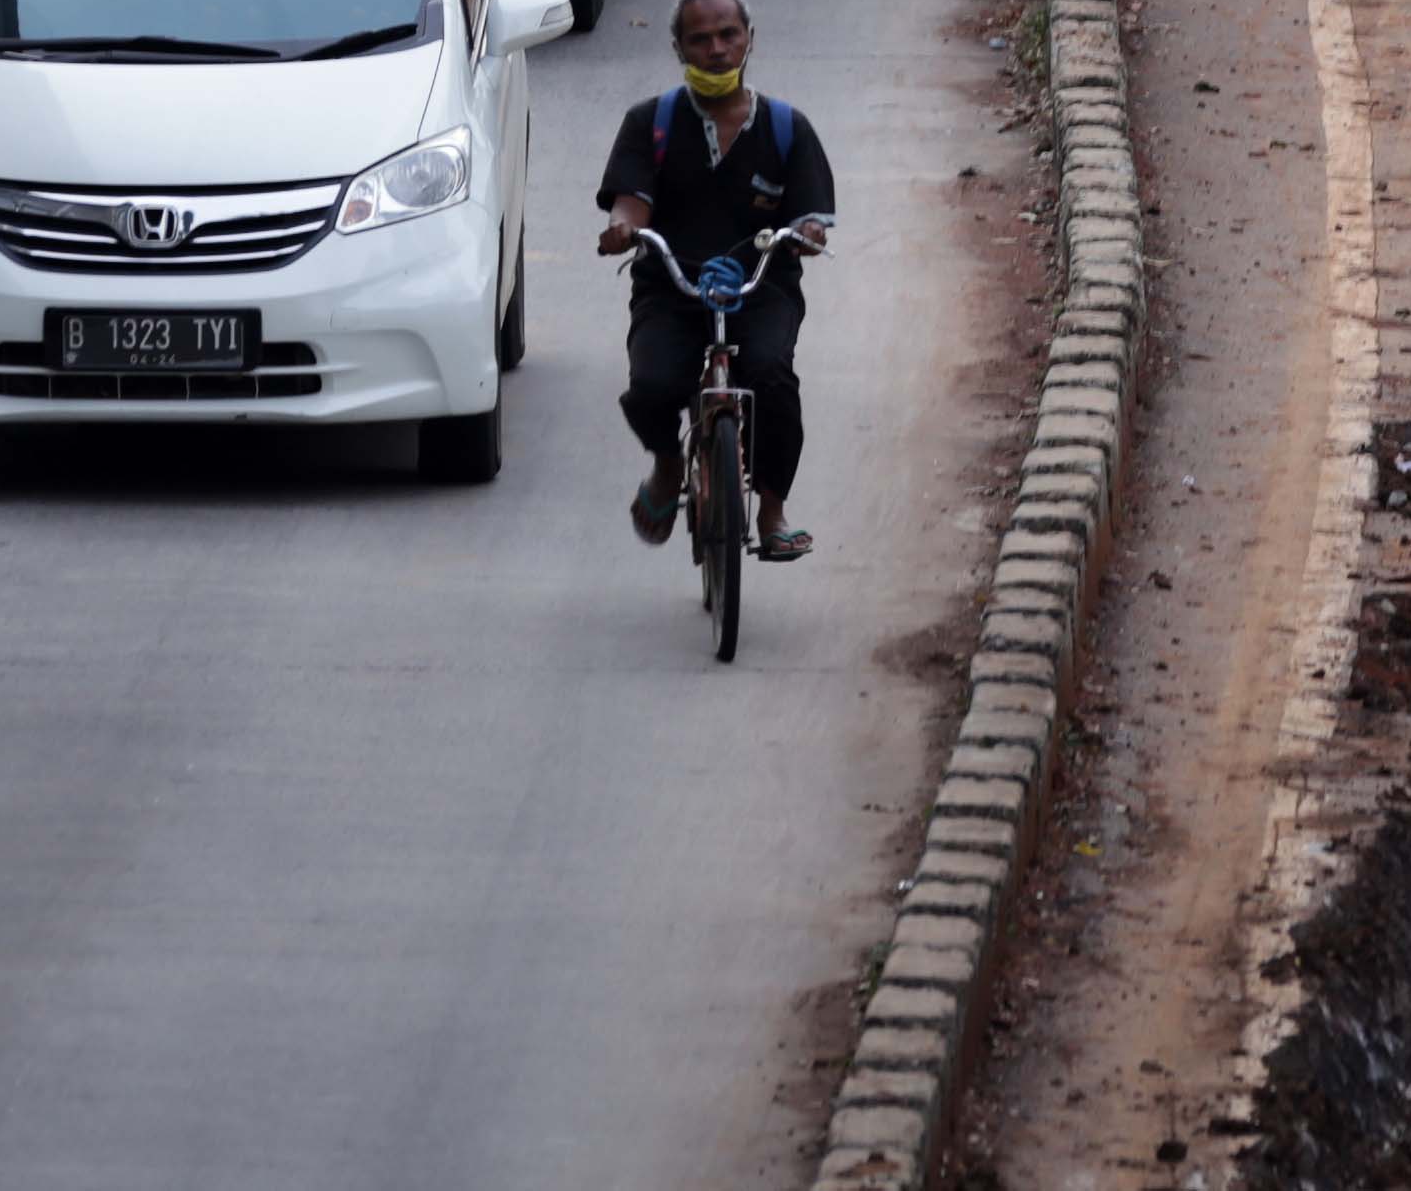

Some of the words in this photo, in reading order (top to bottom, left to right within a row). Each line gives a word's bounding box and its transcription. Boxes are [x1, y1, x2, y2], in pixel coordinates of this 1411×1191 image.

[68, 318, 84, 349] B
[108, 318, 170, 350] 1323
[193, 318, 238, 350] TYI
